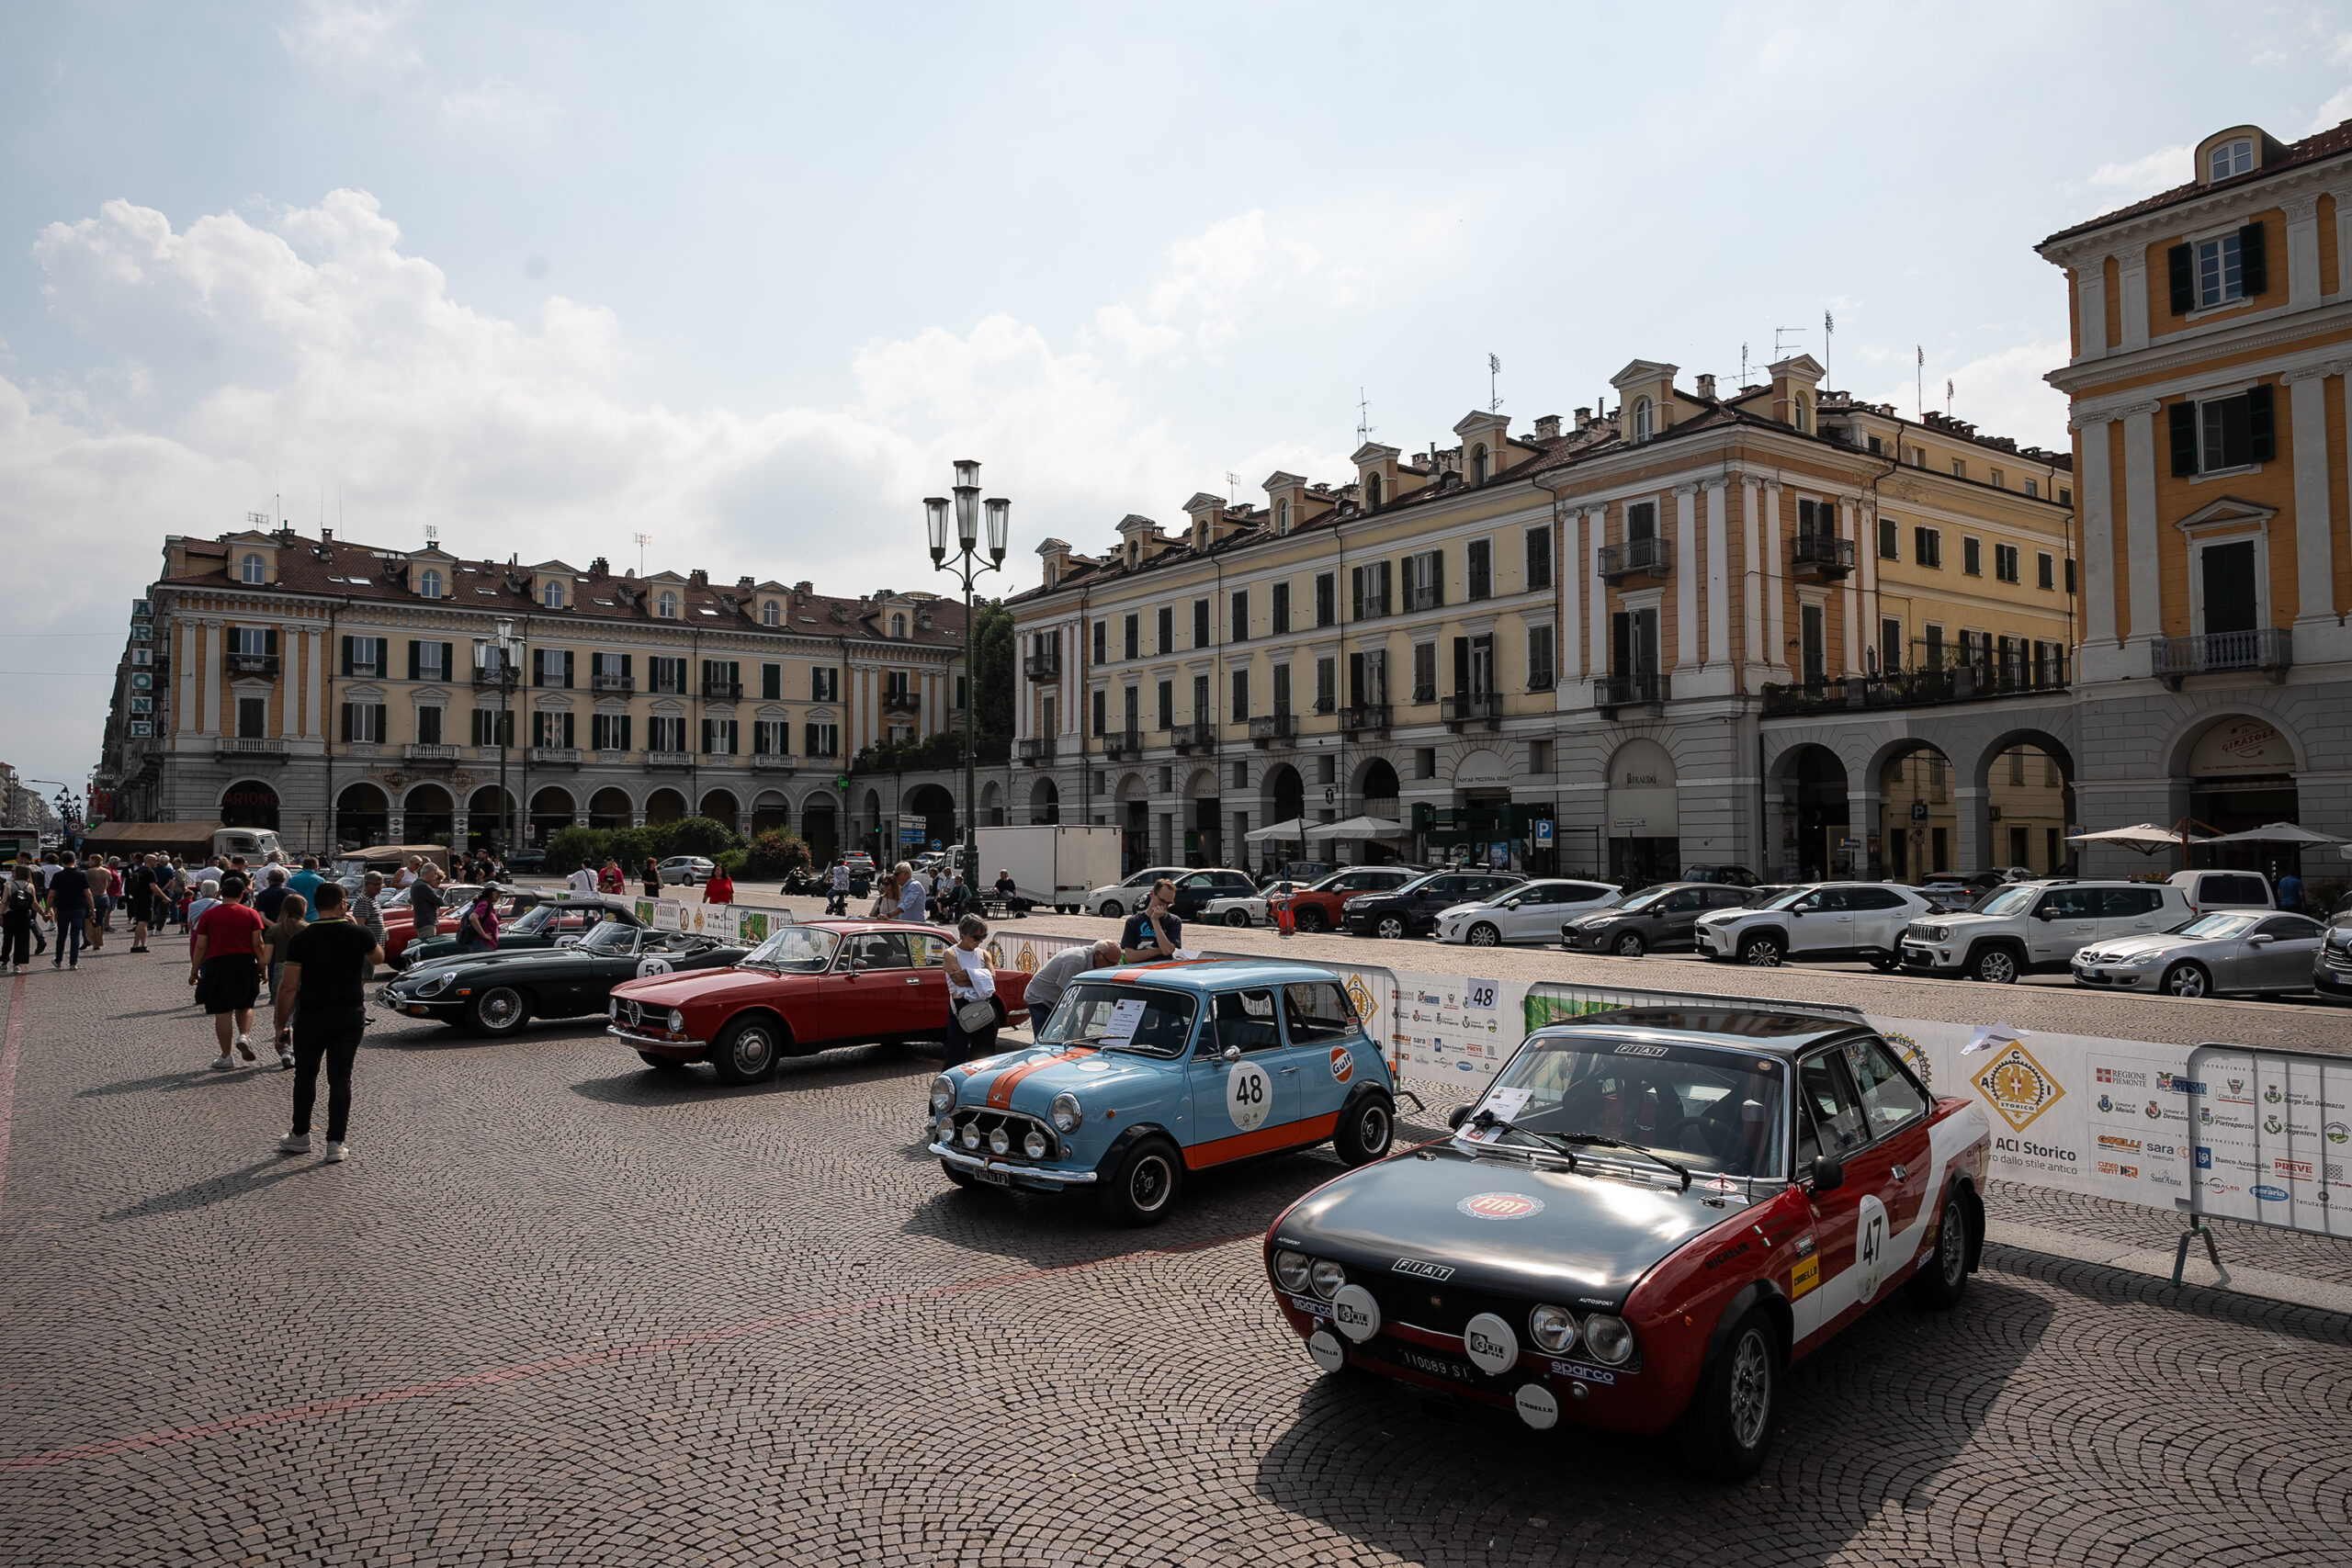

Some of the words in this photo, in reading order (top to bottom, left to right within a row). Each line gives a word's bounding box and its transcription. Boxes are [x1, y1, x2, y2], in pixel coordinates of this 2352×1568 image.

[2222, 729, 2275, 751] GIRASOLE
[223, 790, 280, 806] ARIONE
[1914, 806, 1924, 819] P
[1539, 822, 1549, 837] P
[645, 964, 664, 976] 51
[1473, 987, 1494, 1007] 48
[1895, 1037, 1915, 1049] CLUB
[1620, 1045, 1664, 1055] FIAT
[1332, 1055, 1351, 1074] Gulf
[1918, 1055, 1928, 1081] CUNEO
[2112, 1069, 2147, 1080] REGIONE
[2112, 1077, 2147, 1088] PIEMONTE
[1237, 1075, 1262, 1105] 48
[2000, 1102, 2034, 1111] STORICO
[2284, 1097, 2301, 1106] Borgo
[2315, 1100, 2346, 1110] Dalmazzo
[2164, 1112, 2189, 1122] Demonte
[2215, 1120, 2255, 1130] Pietraporzio
[2284, 1128, 2317, 1137] Argentera
[2098, 1135, 2142, 1148] GARELLI
[1996, 1137, 2019, 1152] ACI
[2024, 1142, 2076, 1161] Storico
[2147, 1143, 2175, 1155] sara
[2001, 1156, 2023, 1166] dallo
[2026, 1159, 2045, 1169] stile
[2048, 1163, 2077, 1175] antico
[2098, 1161, 2119, 1169] CUNEO
[2215, 1156, 2236, 1166] Banco
[2237, 1159, 2271, 1169] Azzoaglio
[2275, 1161, 2312, 1174] PREVE
[2098, 1167, 2119, 1175] RENT
[2275, 1169, 2313, 1179] COSTRUZIONI
[1475, 1197, 1530, 1213] FIAT
[2296, 1199, 2318, 1207] Tenuta
[1278, 1237, 1301, 1247] AUTOSPORT
[1863, 1215, 1883, 1266] 47
[1705, 1242, 1750, 1270] MICHELIN
[1398, 1260, 1449, 1277] FIAT
[1793, 1265, 1817, 1287] CARELLO
[1292, 1298, 1332, 1315] sparco
[1578, 1297, 1614, 1307] AUTOSPORT
[1311, 1344, 1338, 1357] CARELLO
[1404, 1352, 1446, 1374] 110089
[1453, 1365, 1468, 1379] SI
[1551, 1360, 1614, 1382] sparco
[1520, 1401, 1554, 1414] CARELLO
